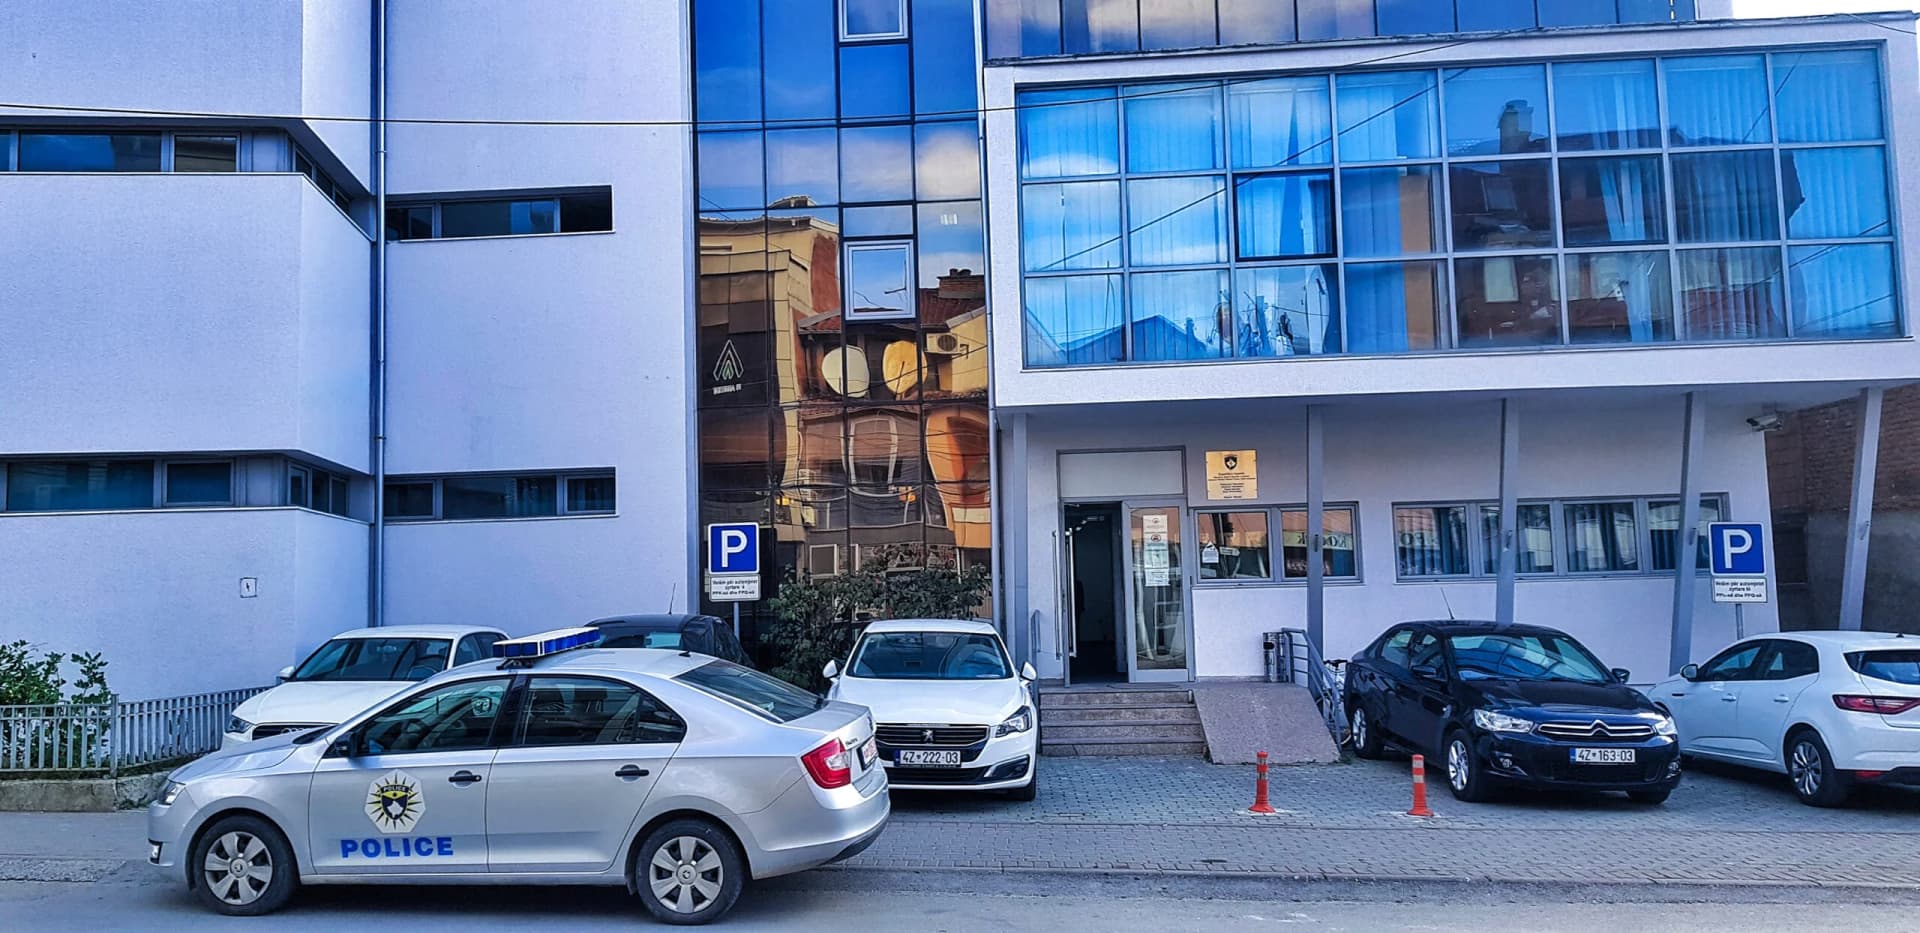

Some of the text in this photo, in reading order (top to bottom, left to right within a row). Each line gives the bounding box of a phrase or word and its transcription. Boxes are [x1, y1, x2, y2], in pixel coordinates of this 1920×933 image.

[721, 530, 748, 568] P
[1723, 529, 1753, 569] P
[340, 837, 454, 859] POLICE
